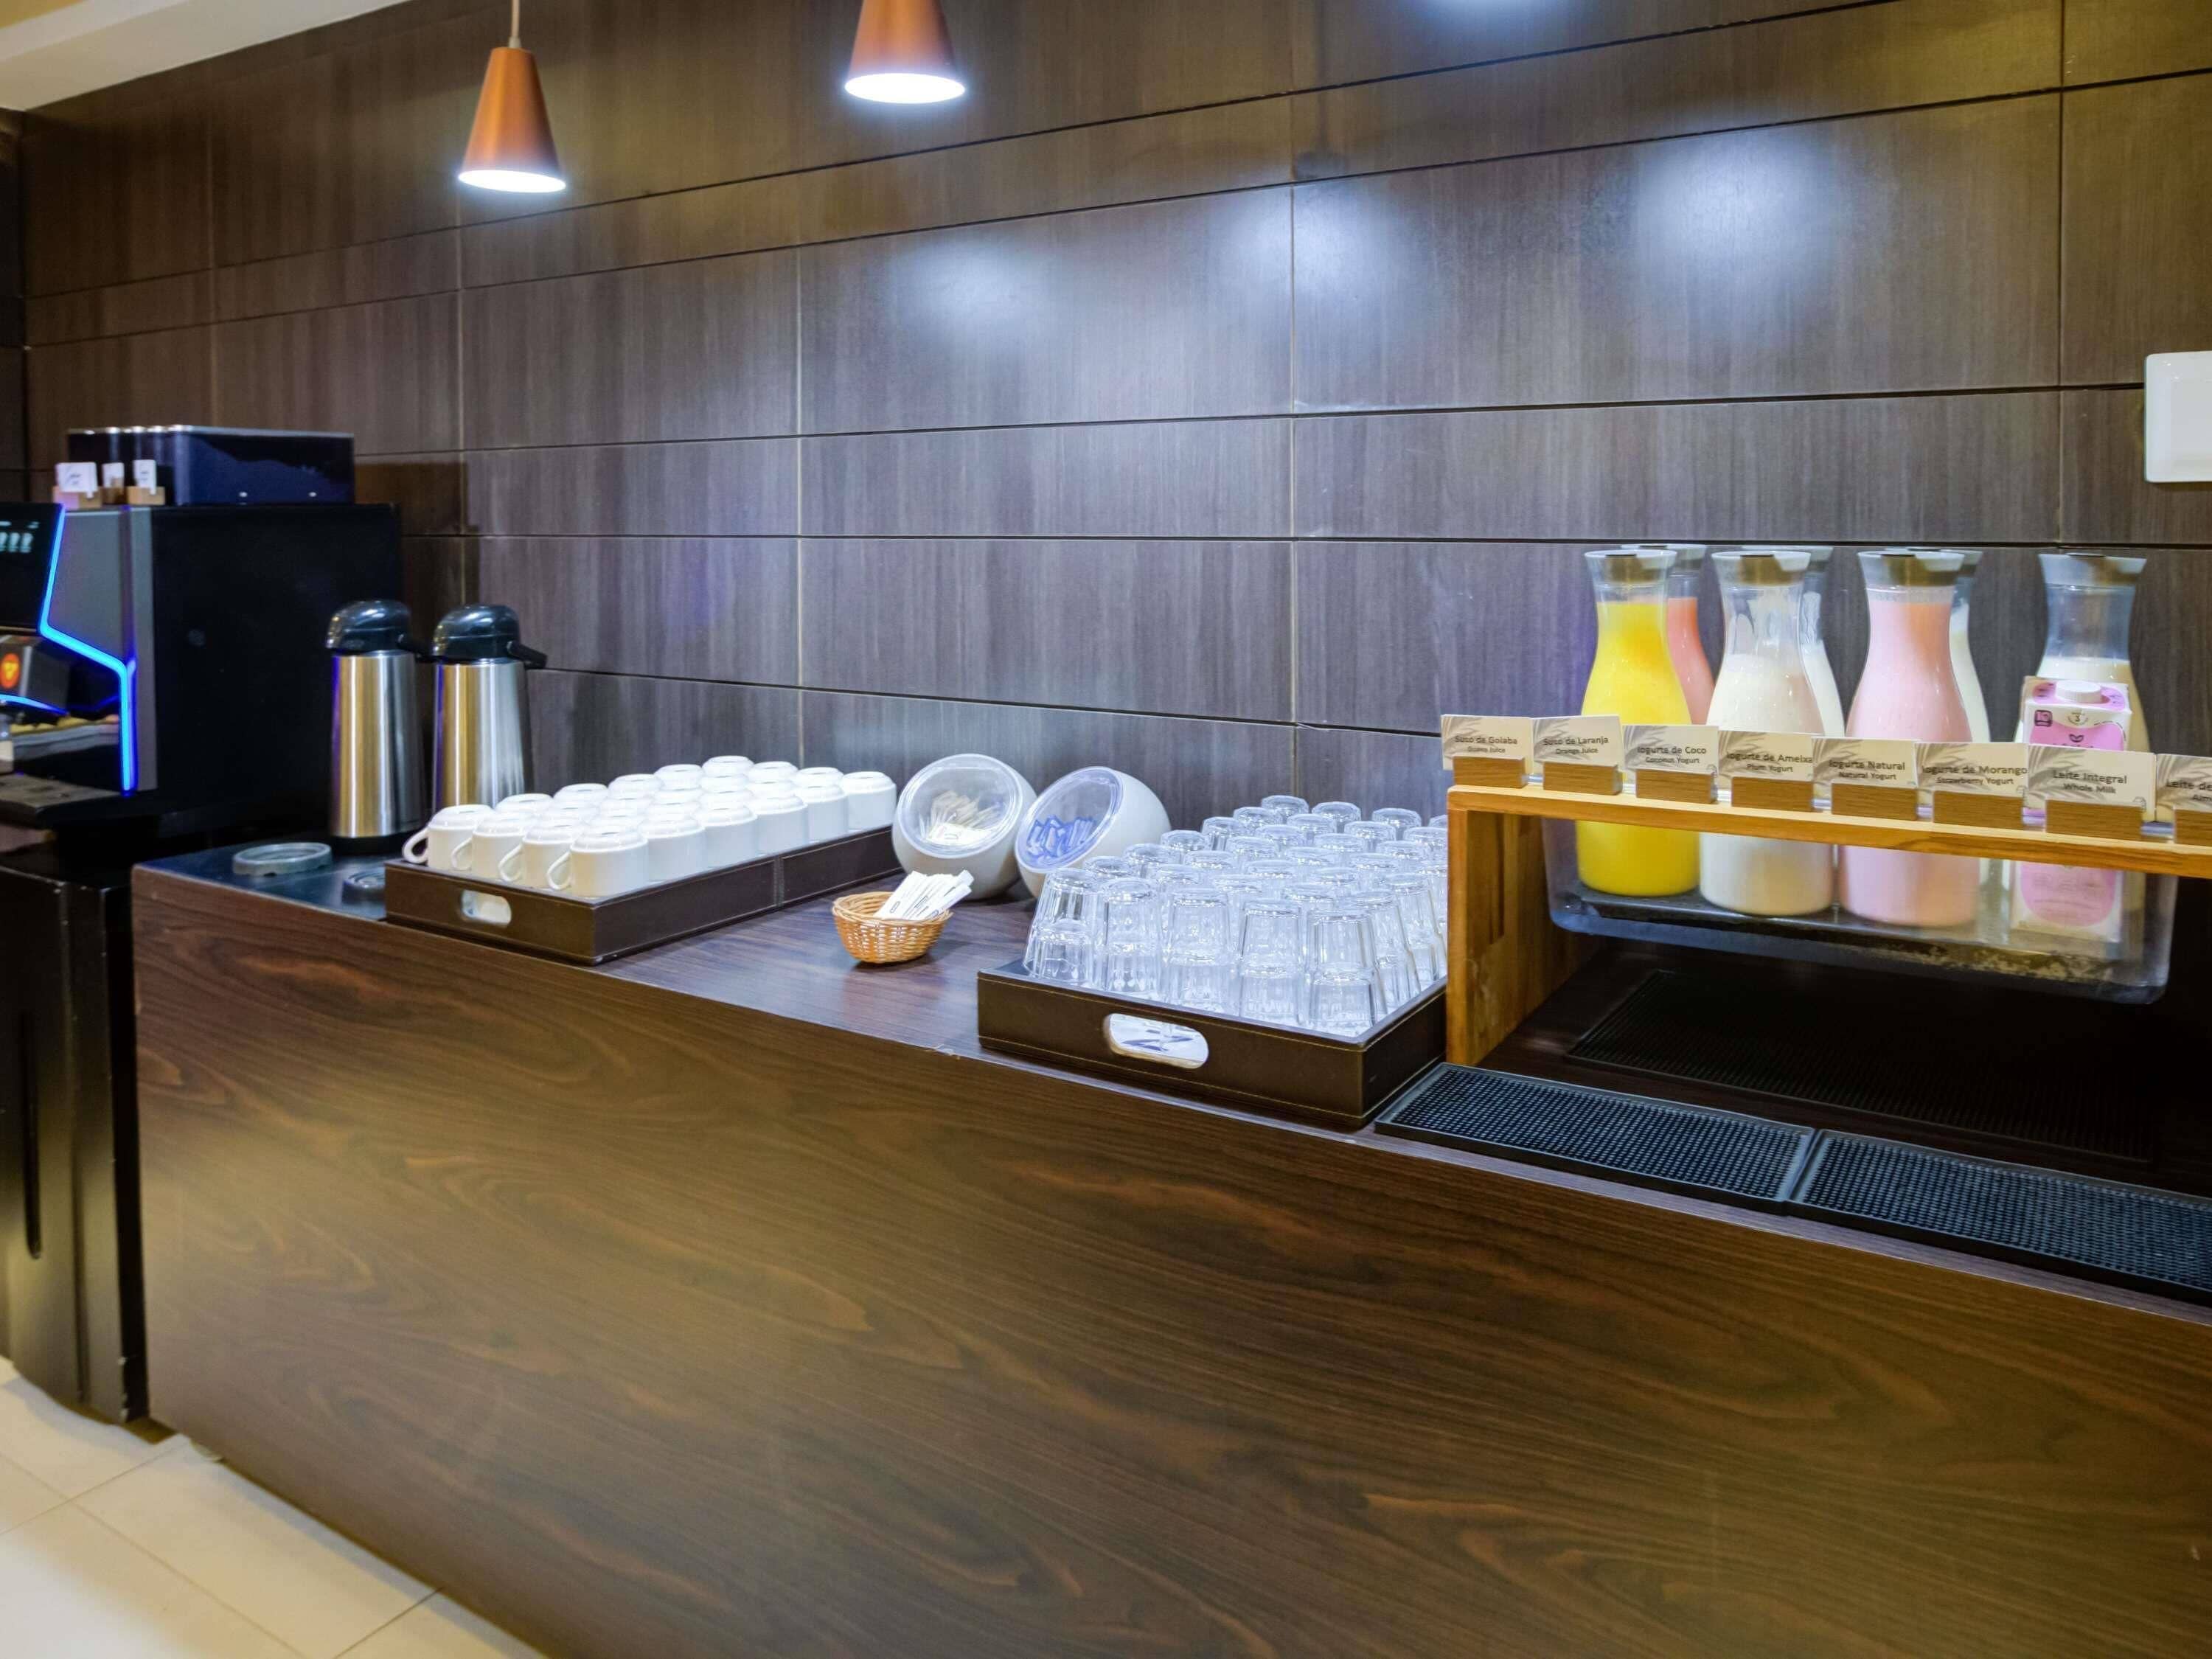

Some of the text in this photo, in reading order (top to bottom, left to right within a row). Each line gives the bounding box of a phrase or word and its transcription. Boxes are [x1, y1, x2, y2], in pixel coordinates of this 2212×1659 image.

[1578, 736, 1609, 745] Laranja
[1638, 746, 1669, 755] Iogurte
[1685, 746, 1707, 754] Coco
[1778, 754, 1812, 763] Ameixa
[1768, 765, 1793, 773] Yogurt
[1829, 759, 1905, 770] Iogurte Natural
[1921, 765, 2028, 776] Iogurte de Morango
[1871, 772, 1896, 780] Yogurt
[1985, 776, 2014, 785] Yogurt
[2053, 770, 2127, 784] Leite Integral
[2063, 783, 2116, 793] Whole Milk
